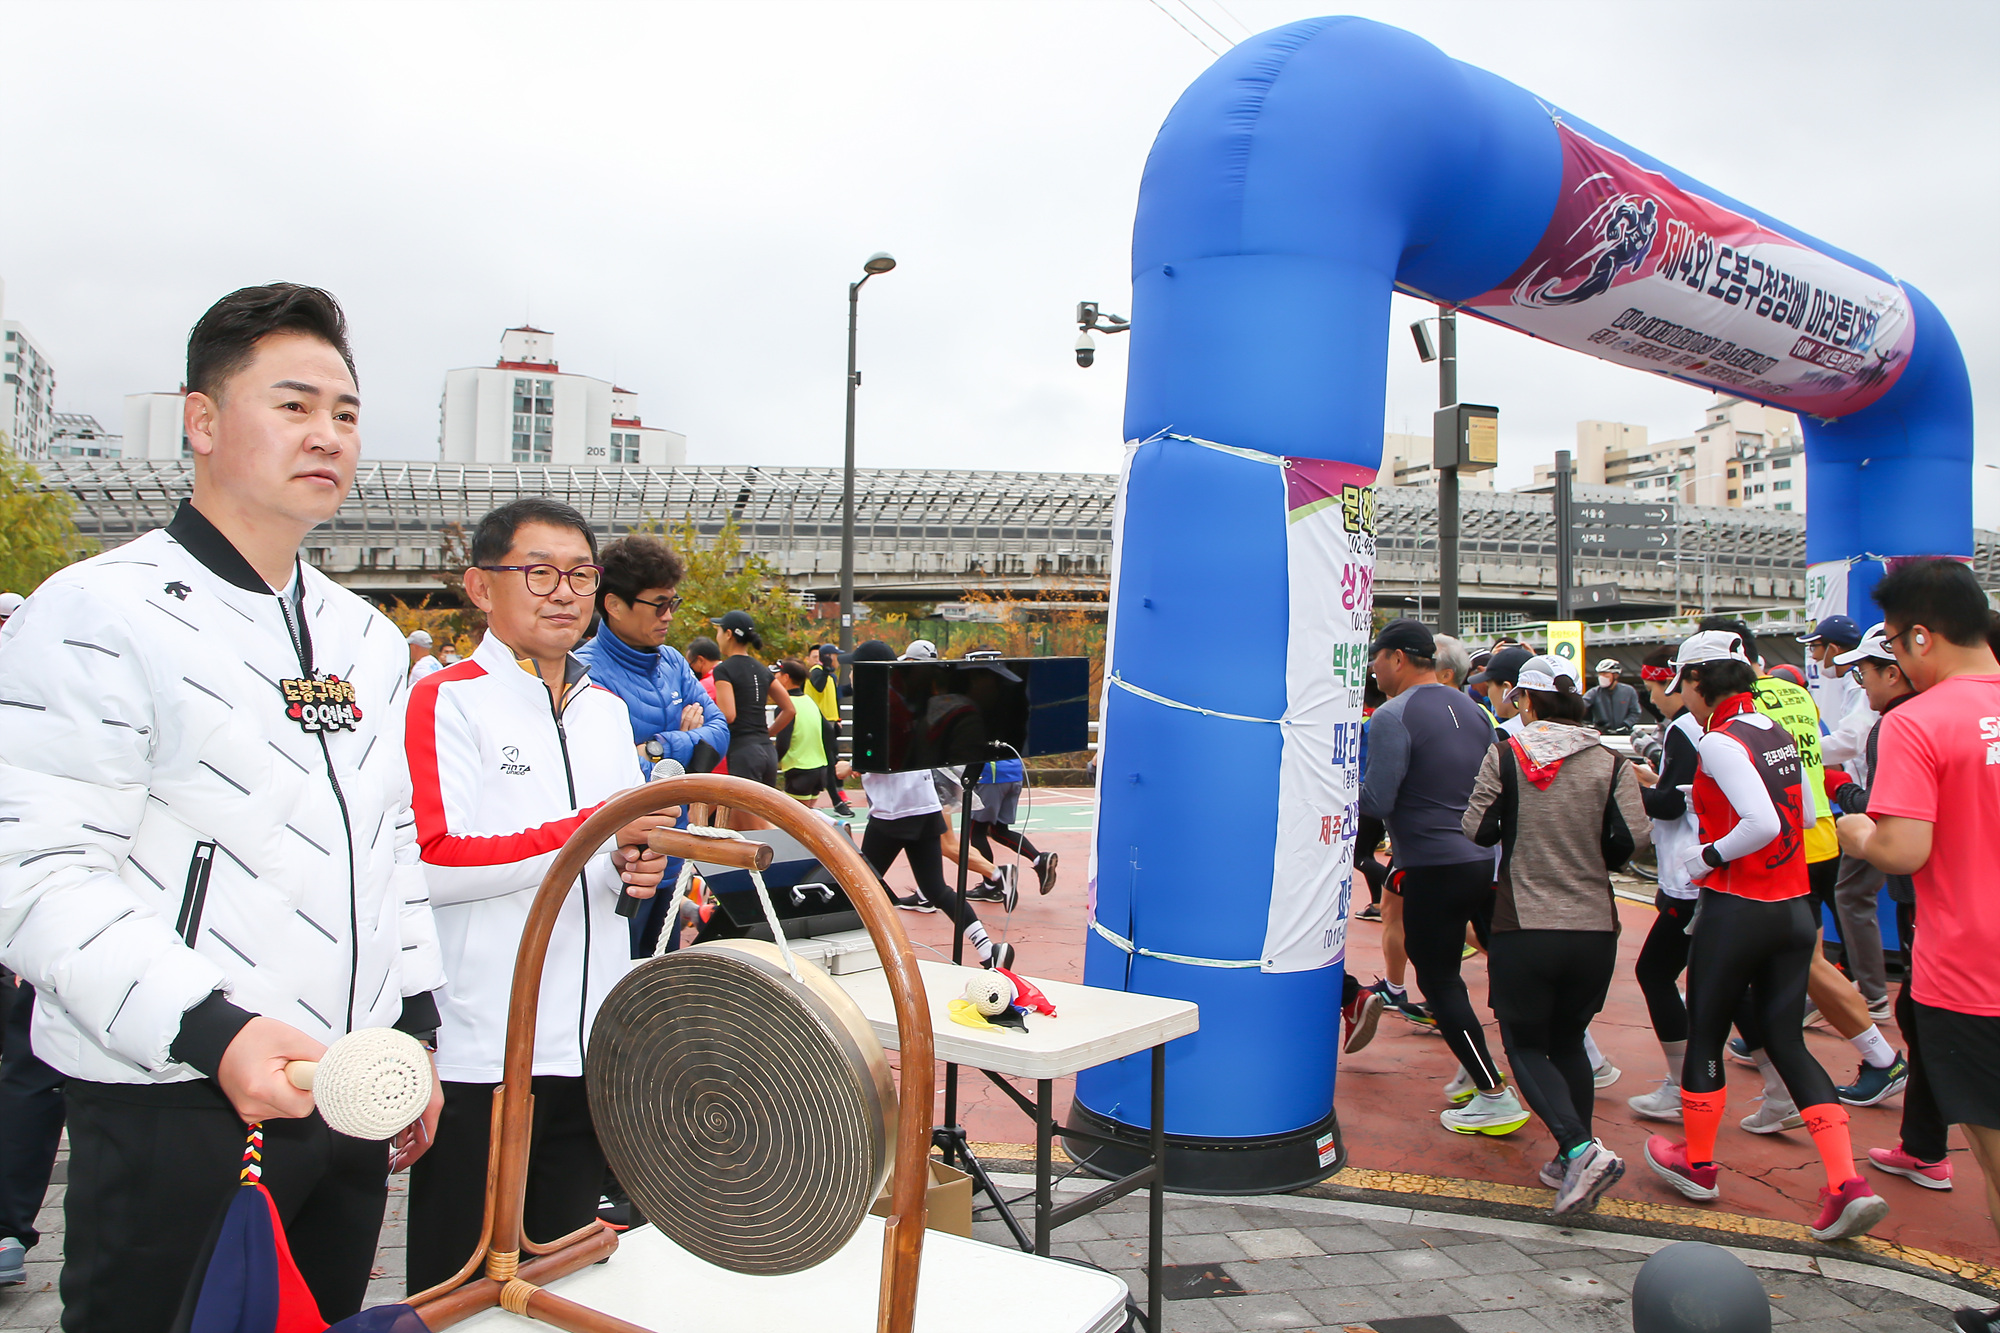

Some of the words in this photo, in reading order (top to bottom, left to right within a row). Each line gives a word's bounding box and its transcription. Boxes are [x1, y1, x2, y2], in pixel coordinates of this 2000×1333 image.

[1707, 246, 1809, 329] 도봉구청장배
[587, 446, 606, 456] 205
[1560, 645, 1570, 657] 4
[282, 679, 356, 702] 도봉구청장
